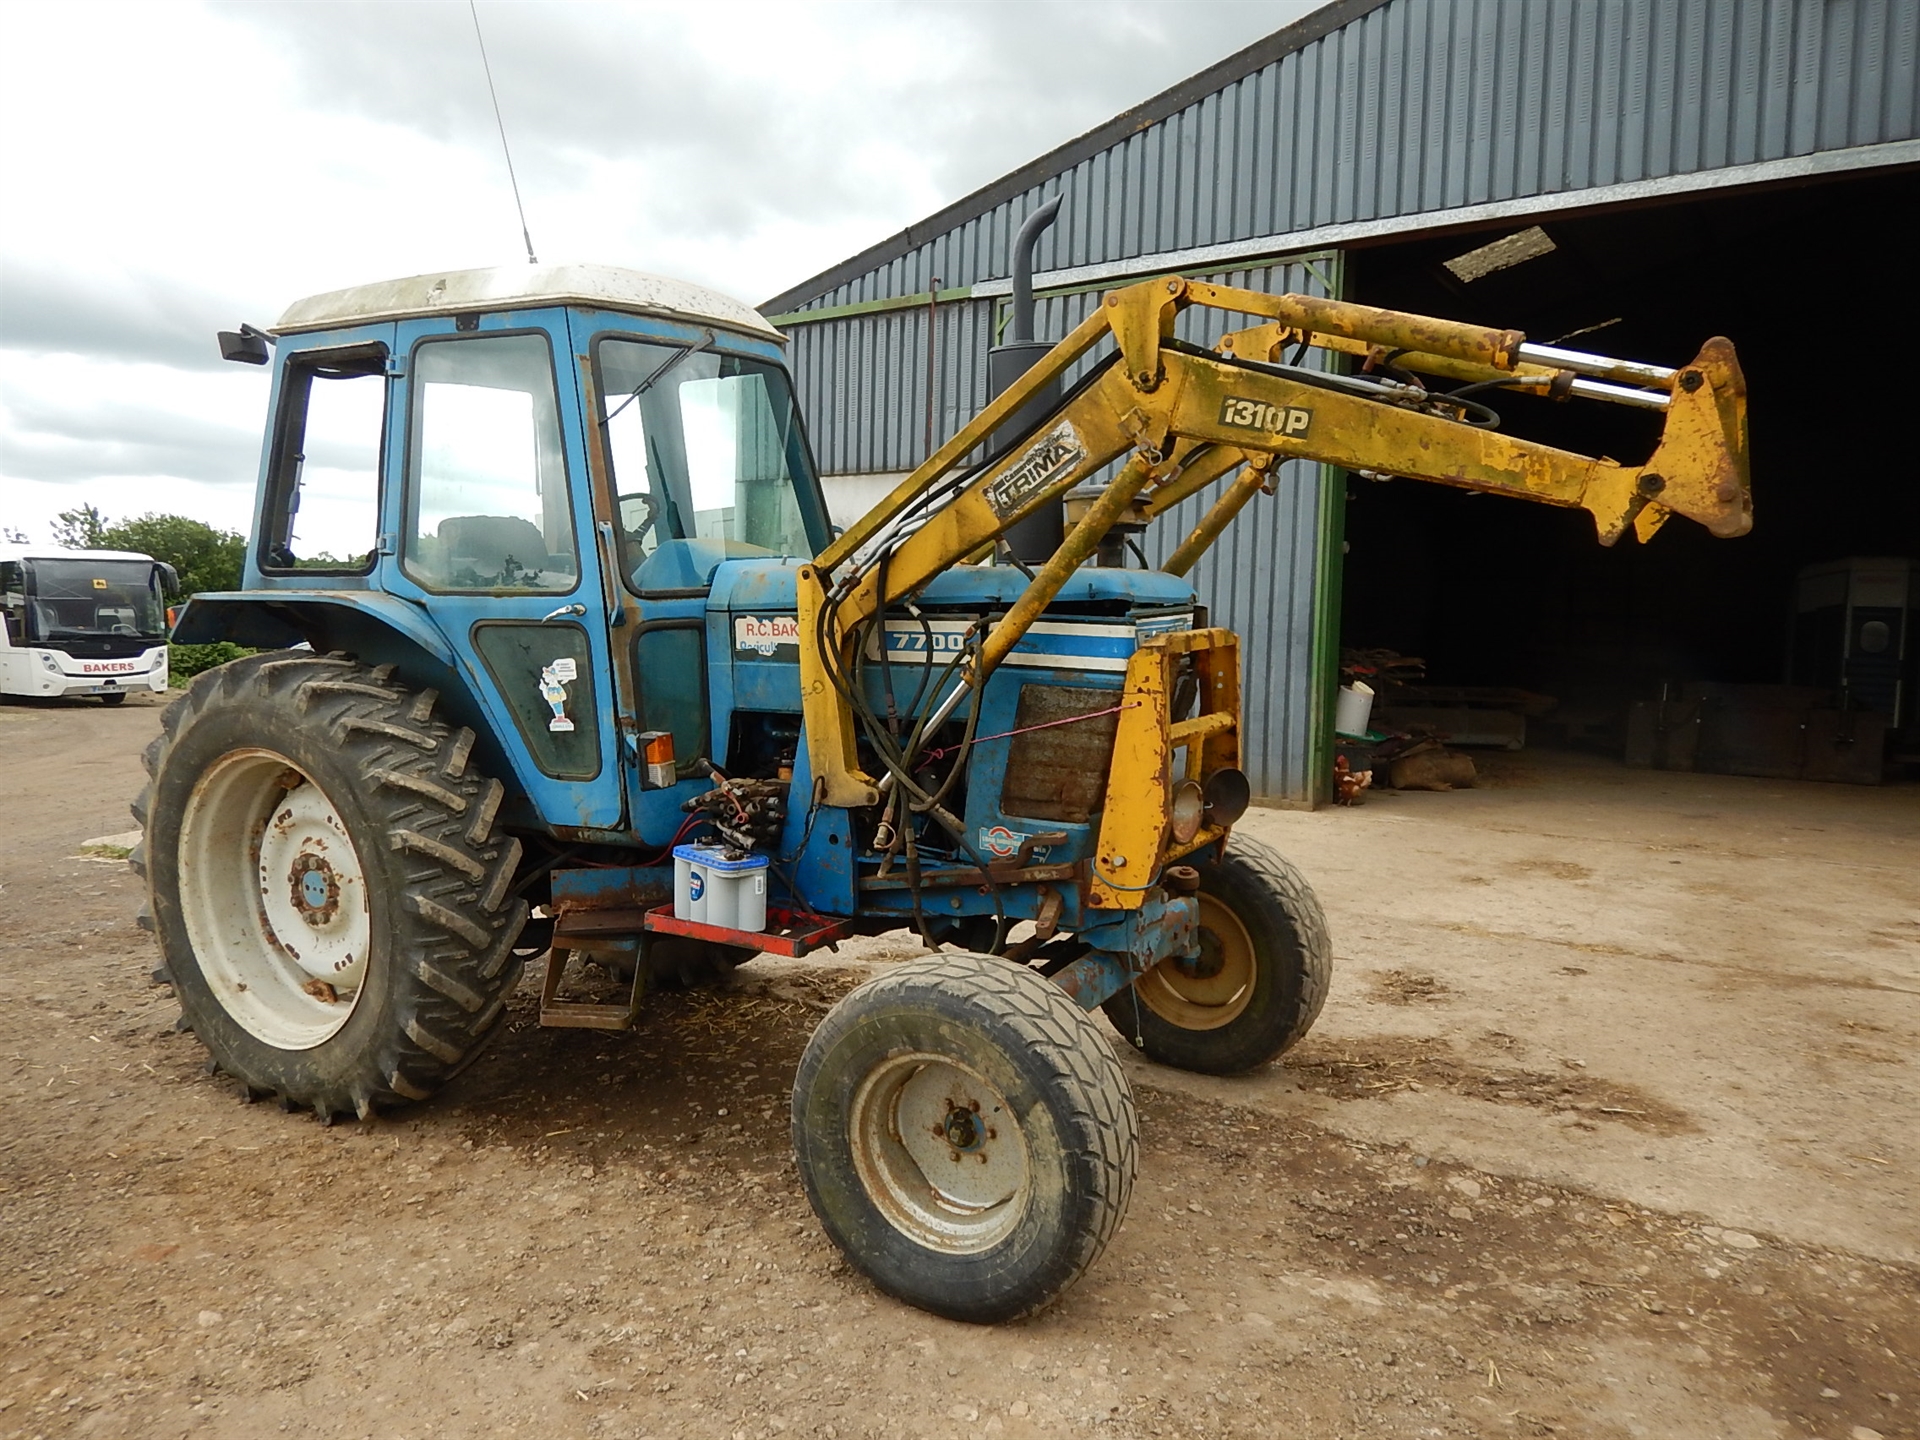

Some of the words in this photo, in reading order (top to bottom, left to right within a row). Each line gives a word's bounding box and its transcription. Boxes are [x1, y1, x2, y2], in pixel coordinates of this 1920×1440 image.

[998, 444, 1074, 504] TRIMA
[893, 633, 964, 650] 7700
[83, 662, 135, 672] BAKERS
